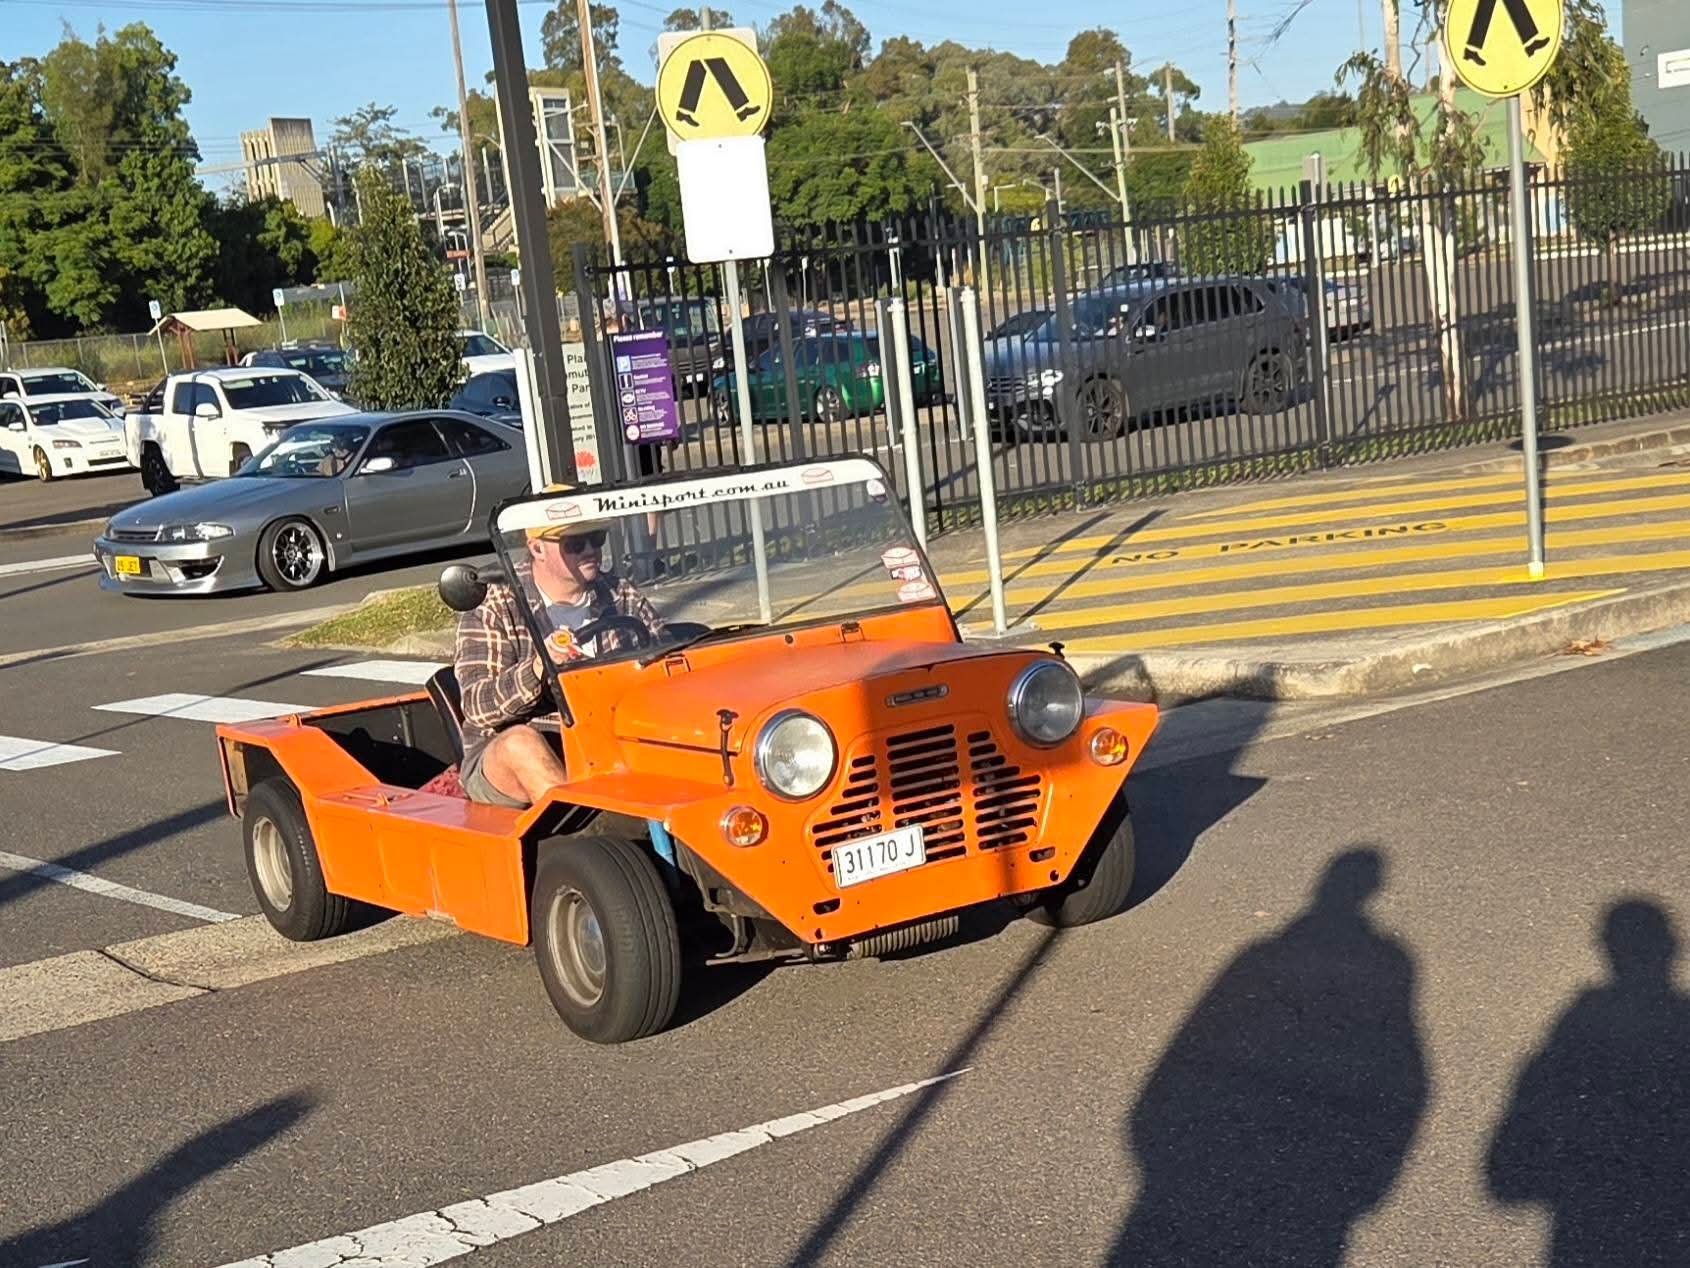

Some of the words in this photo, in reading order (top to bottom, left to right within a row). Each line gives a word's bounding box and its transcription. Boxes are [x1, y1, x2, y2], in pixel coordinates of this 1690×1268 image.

[593, 479, 789, 512] Minisport.com.au
[1112, 550, 1179, 564] NO
[1220, 522, 1447, 552] PARKING
[845, 839, 898, 873] 31170
[905, 834, 915, 857] J
